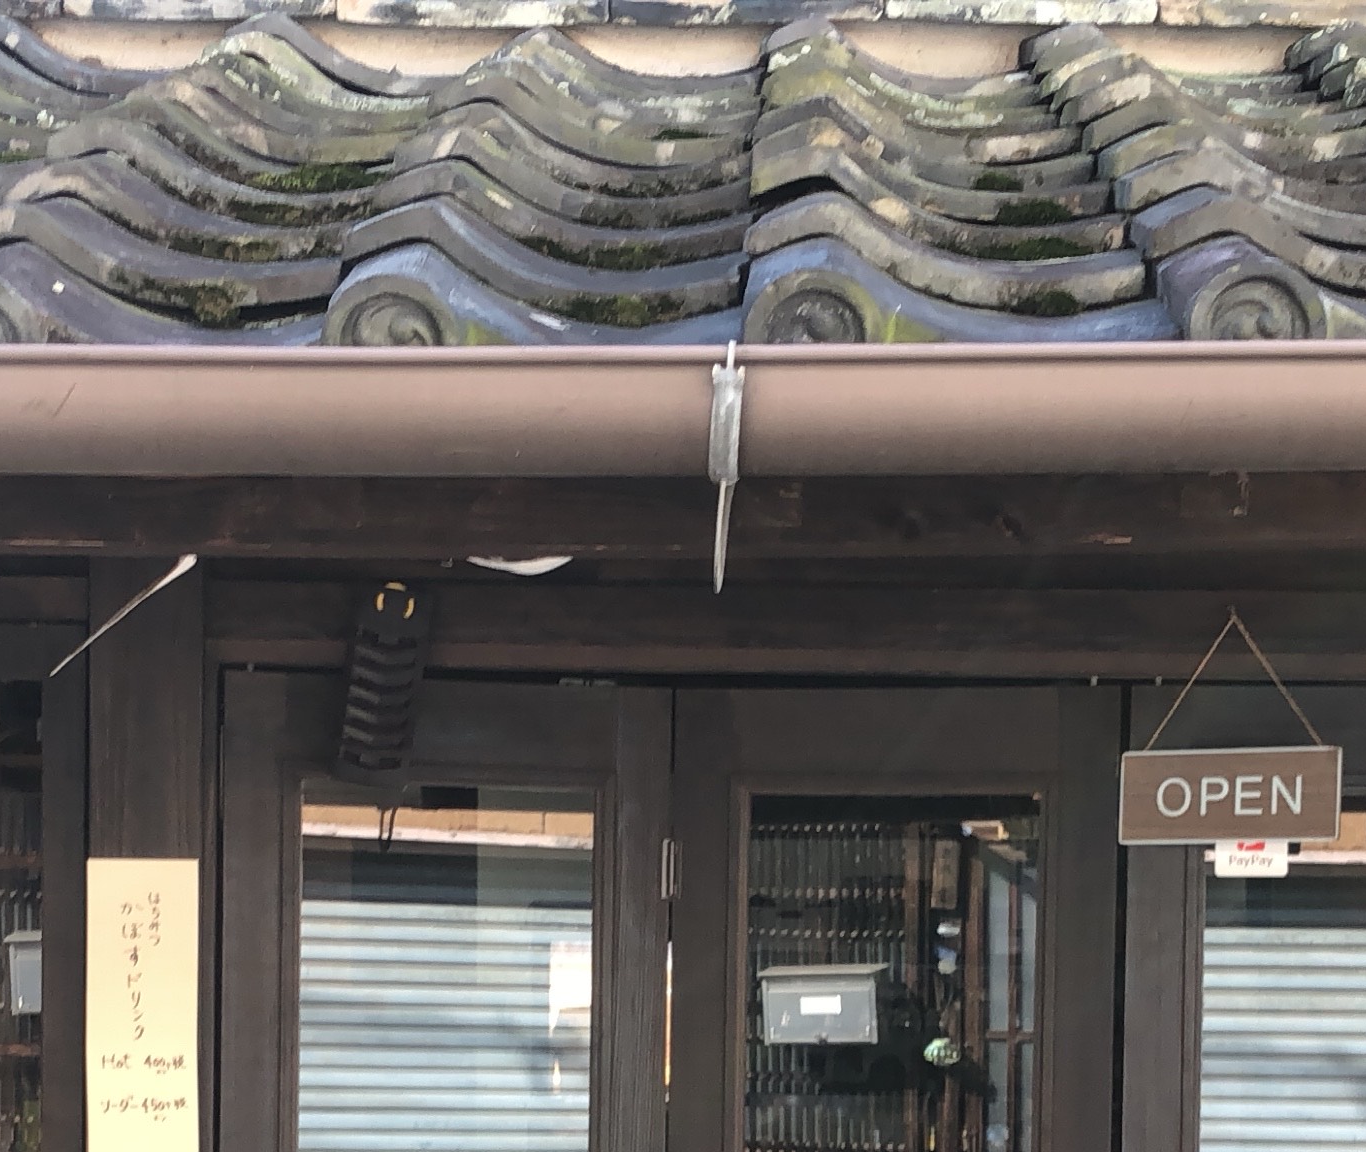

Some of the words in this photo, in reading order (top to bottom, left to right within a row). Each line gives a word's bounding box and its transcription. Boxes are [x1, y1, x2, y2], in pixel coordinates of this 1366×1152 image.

[1156, 774, 1303, 818] OPEN
[1229, 854, 1273, 868] PayPay
[102, 1053, 131, 1069] Hot
